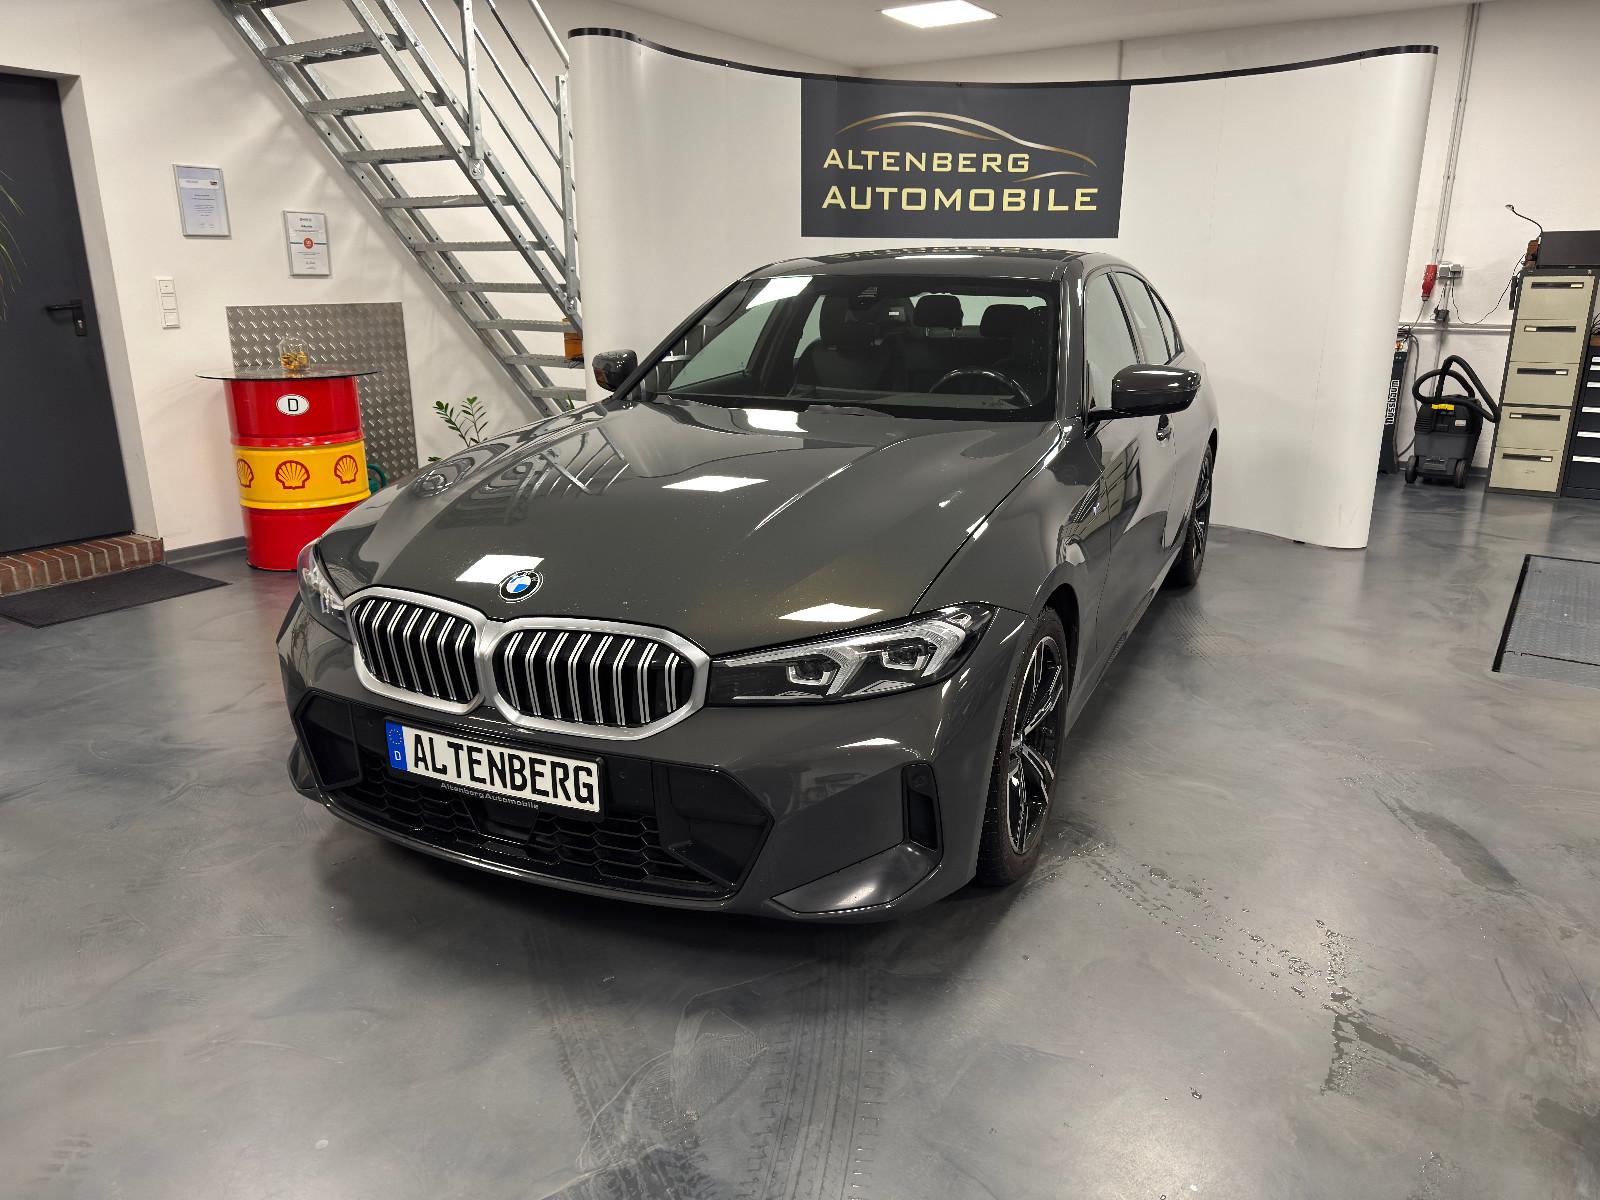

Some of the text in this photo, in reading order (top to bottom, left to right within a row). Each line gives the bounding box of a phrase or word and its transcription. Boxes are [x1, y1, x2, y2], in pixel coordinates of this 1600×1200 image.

[823, 149, 1030, 173] ALTENBERG
[821, 185, 1099, 212] AUTOMOBILE
[287, 398, 299, 411] D
[394, 751, 402, 761] D
[414, 733, 595, 805] ALTENBERG
